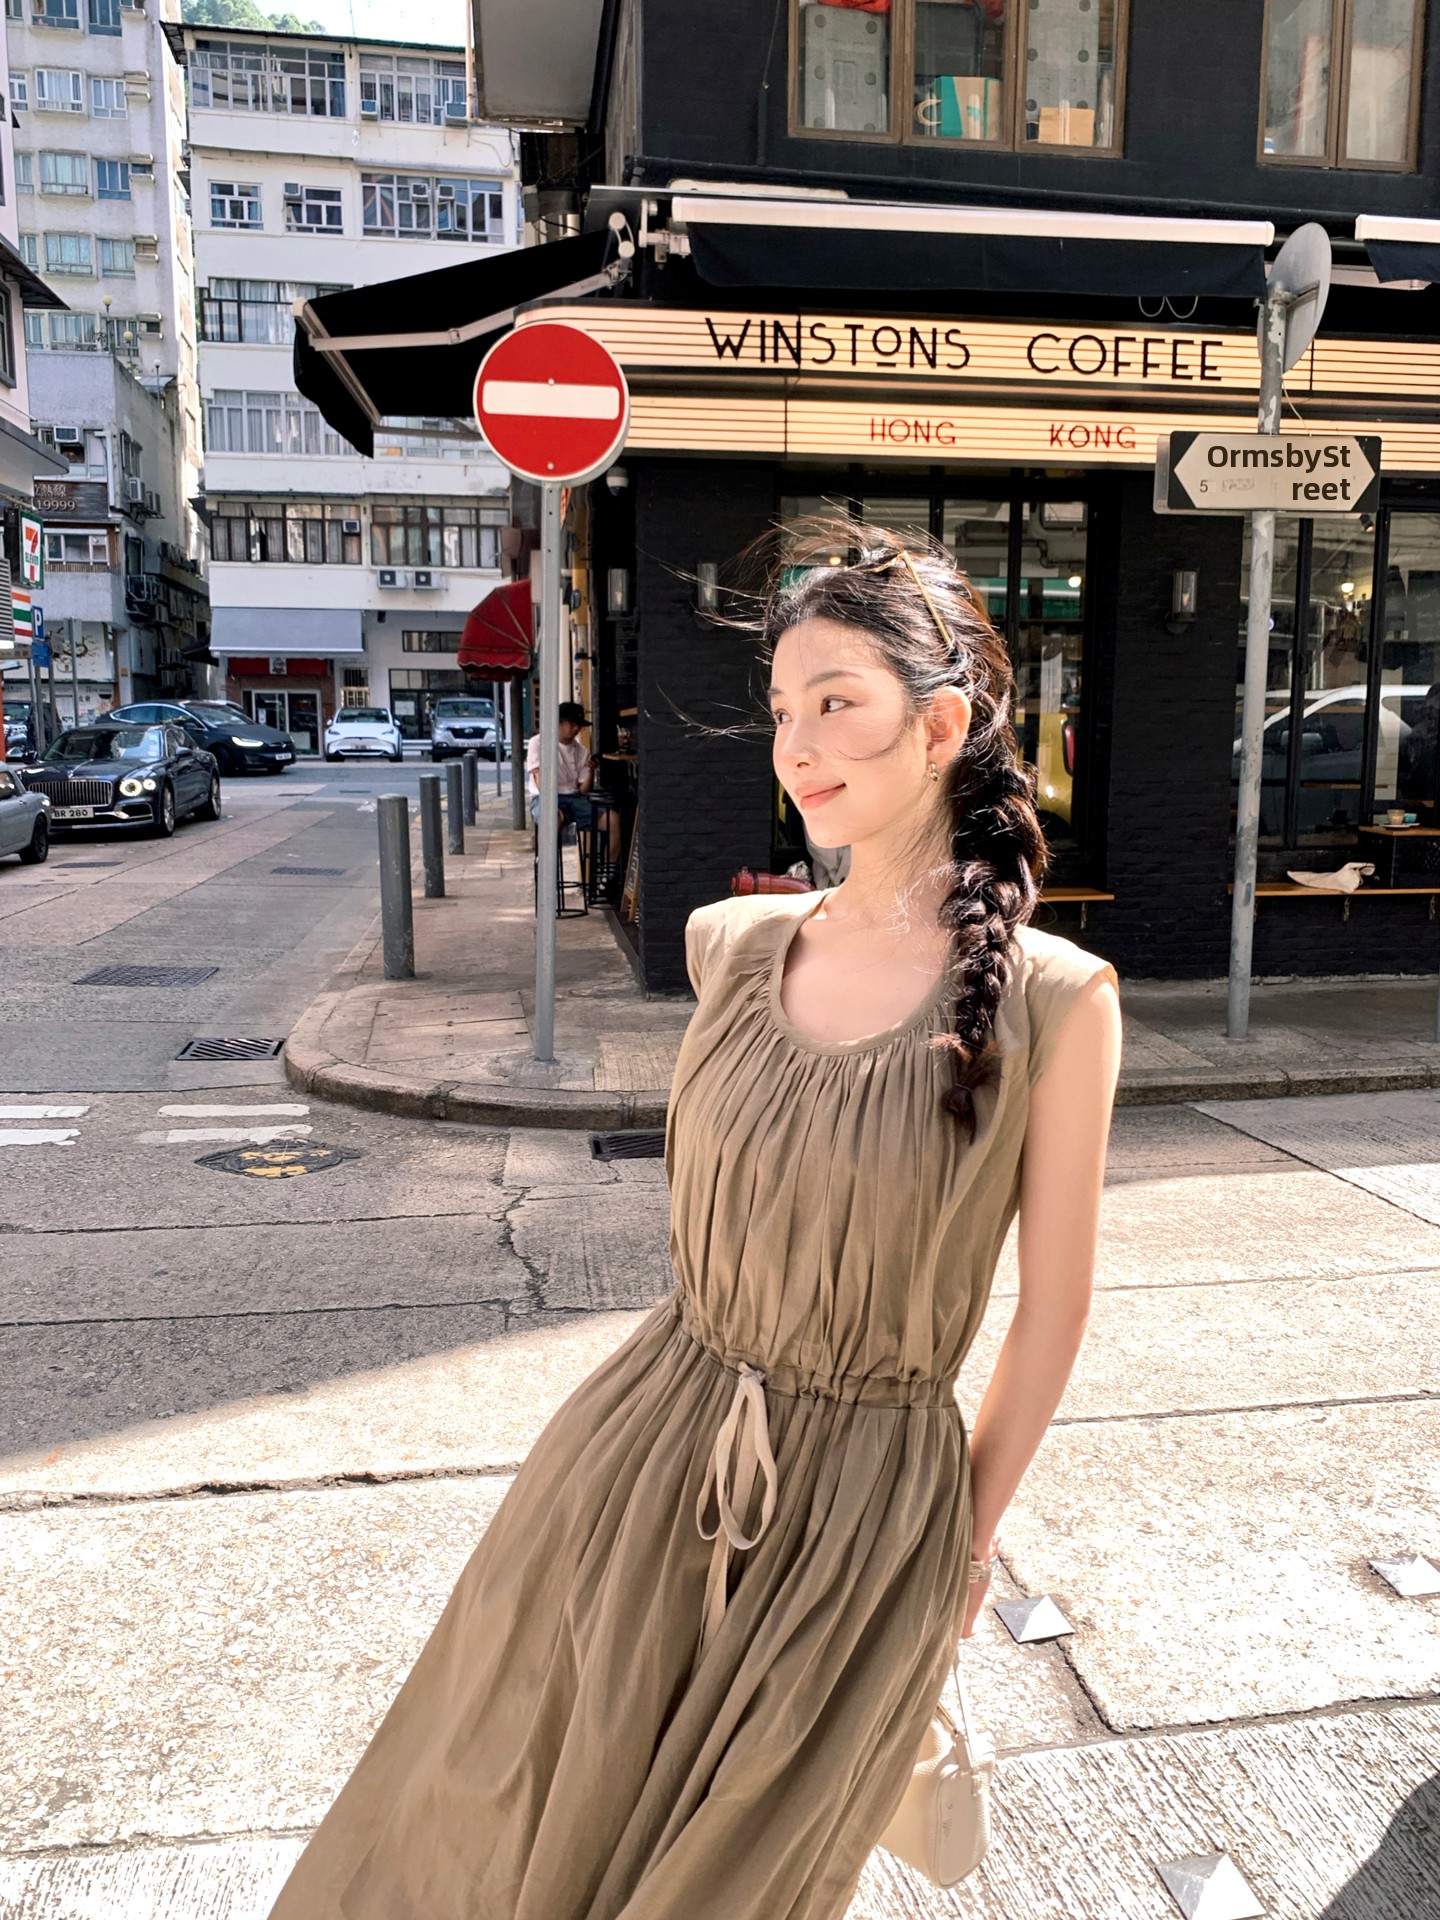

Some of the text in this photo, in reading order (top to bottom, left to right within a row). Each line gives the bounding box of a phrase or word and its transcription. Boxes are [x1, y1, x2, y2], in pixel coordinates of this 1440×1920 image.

[706, 317, 1223, 381] WINSTONS COFFEE
[871, 418, 1137, 449] HONG KONG
[1207, 442, 1351, 473] OrmsbySt
[1199, 480, 1209, 494] 5
[1292, 478, 1351, 501] reet
[35, 609, 42, 636] P
[68, 809, 88, 817] 280
